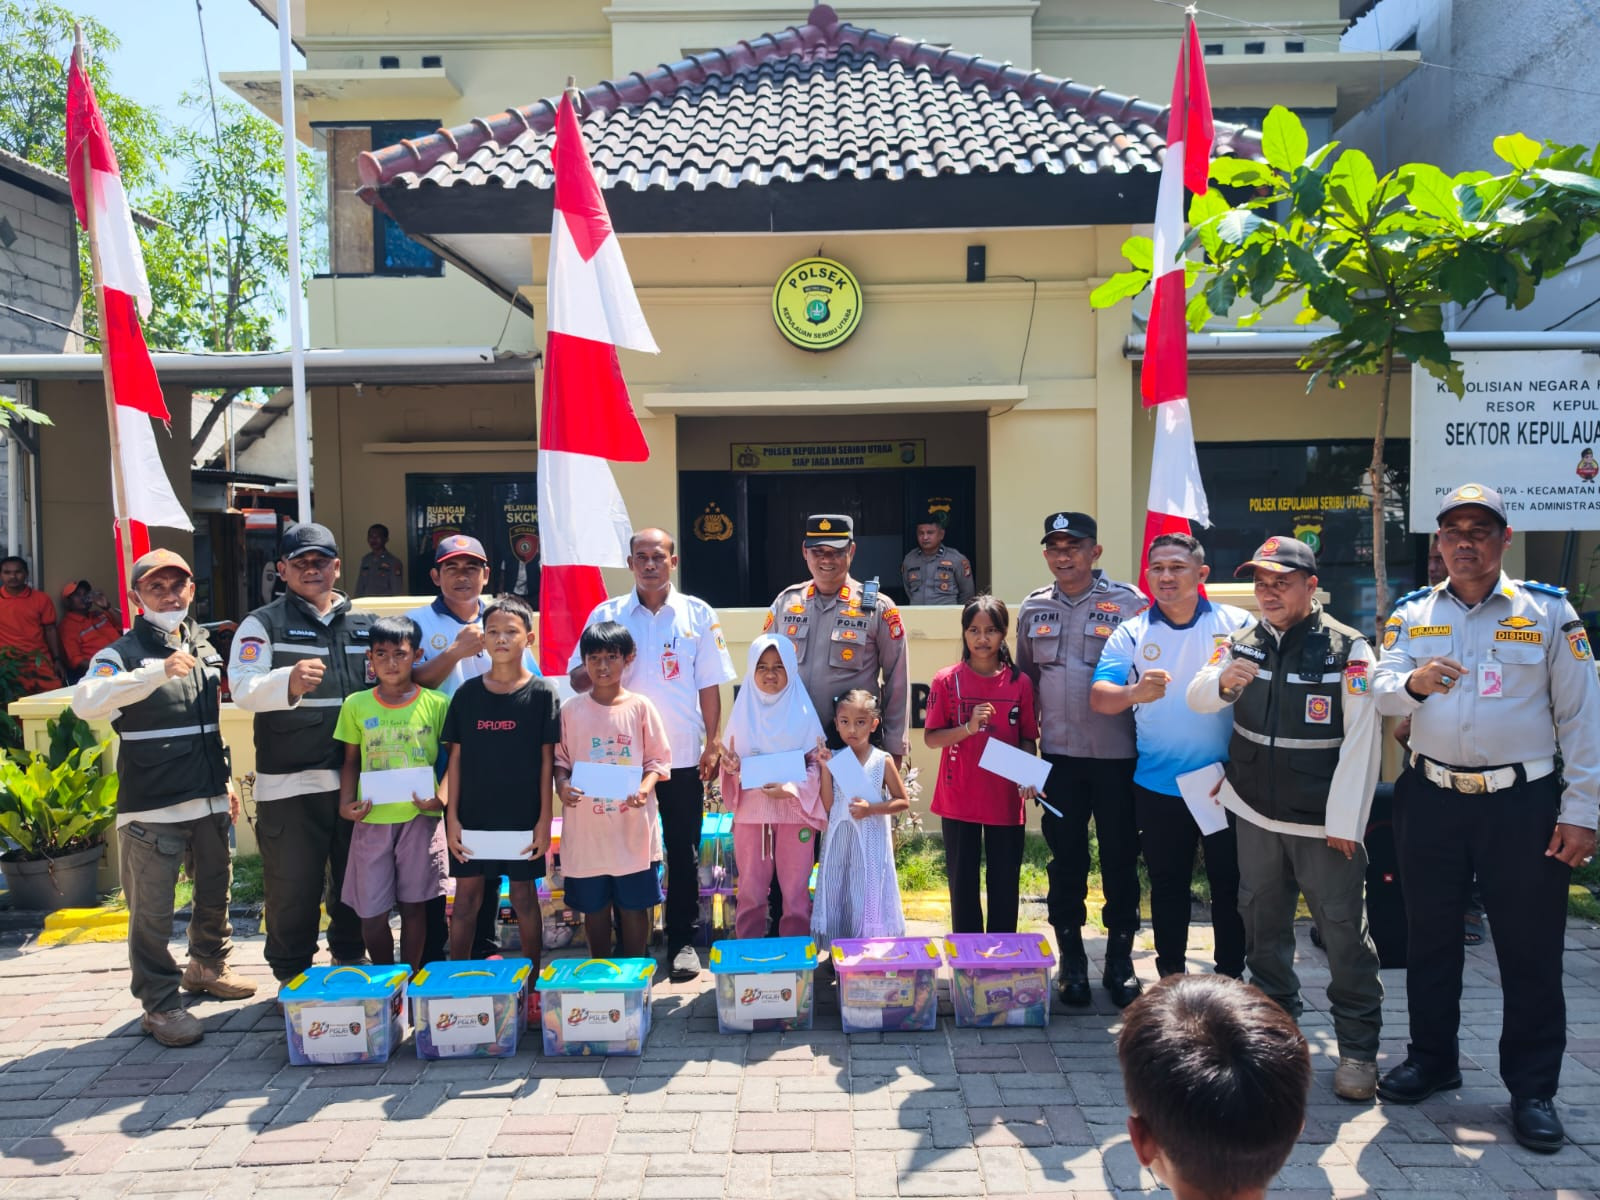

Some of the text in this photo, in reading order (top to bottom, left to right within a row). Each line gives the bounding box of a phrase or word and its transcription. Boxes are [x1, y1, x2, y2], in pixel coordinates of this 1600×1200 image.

[788, 267, 847, 290] POLSEK
[782, 307, 852, 338] KEPULAUAN SERIBU UTARA
[1437, 382, 1522, 393] KOLISIAN
[1529, 380, 1590, 391] NEGARA
[1486, 401, 1535, 412] RESOR
[1446, 422, 1510, 445] SEKTOR
[1527, 486, 1595, 495] KECAMATAN
[427, 505, 466, 513] RUANGAN
[1250, 498, 1276, 512] POLSEK
[1278, 497, 1318, 511] KEPULAUAN
[1320, 496, 1344, 509] SERIBU
[837, 619, 867, 628] POLRI
[1088, 612, 1123, 624] POLRI
